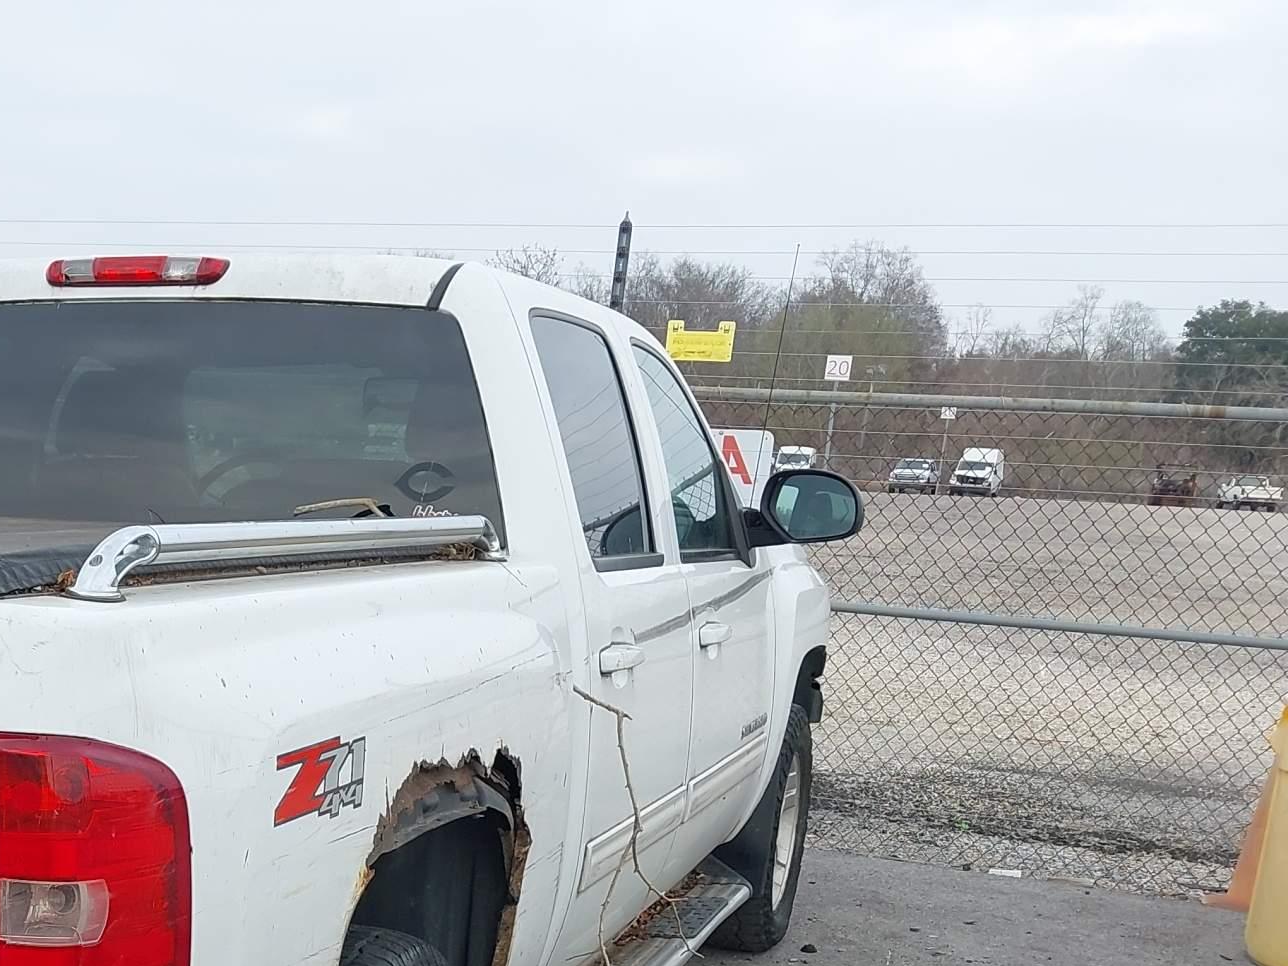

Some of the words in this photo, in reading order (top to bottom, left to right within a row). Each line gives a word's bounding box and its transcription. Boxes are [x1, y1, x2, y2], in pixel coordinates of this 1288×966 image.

[826, 359, 850, 376] 20
[722, 434, 753, 485] A
[273, 735, 366, 828] Z71
